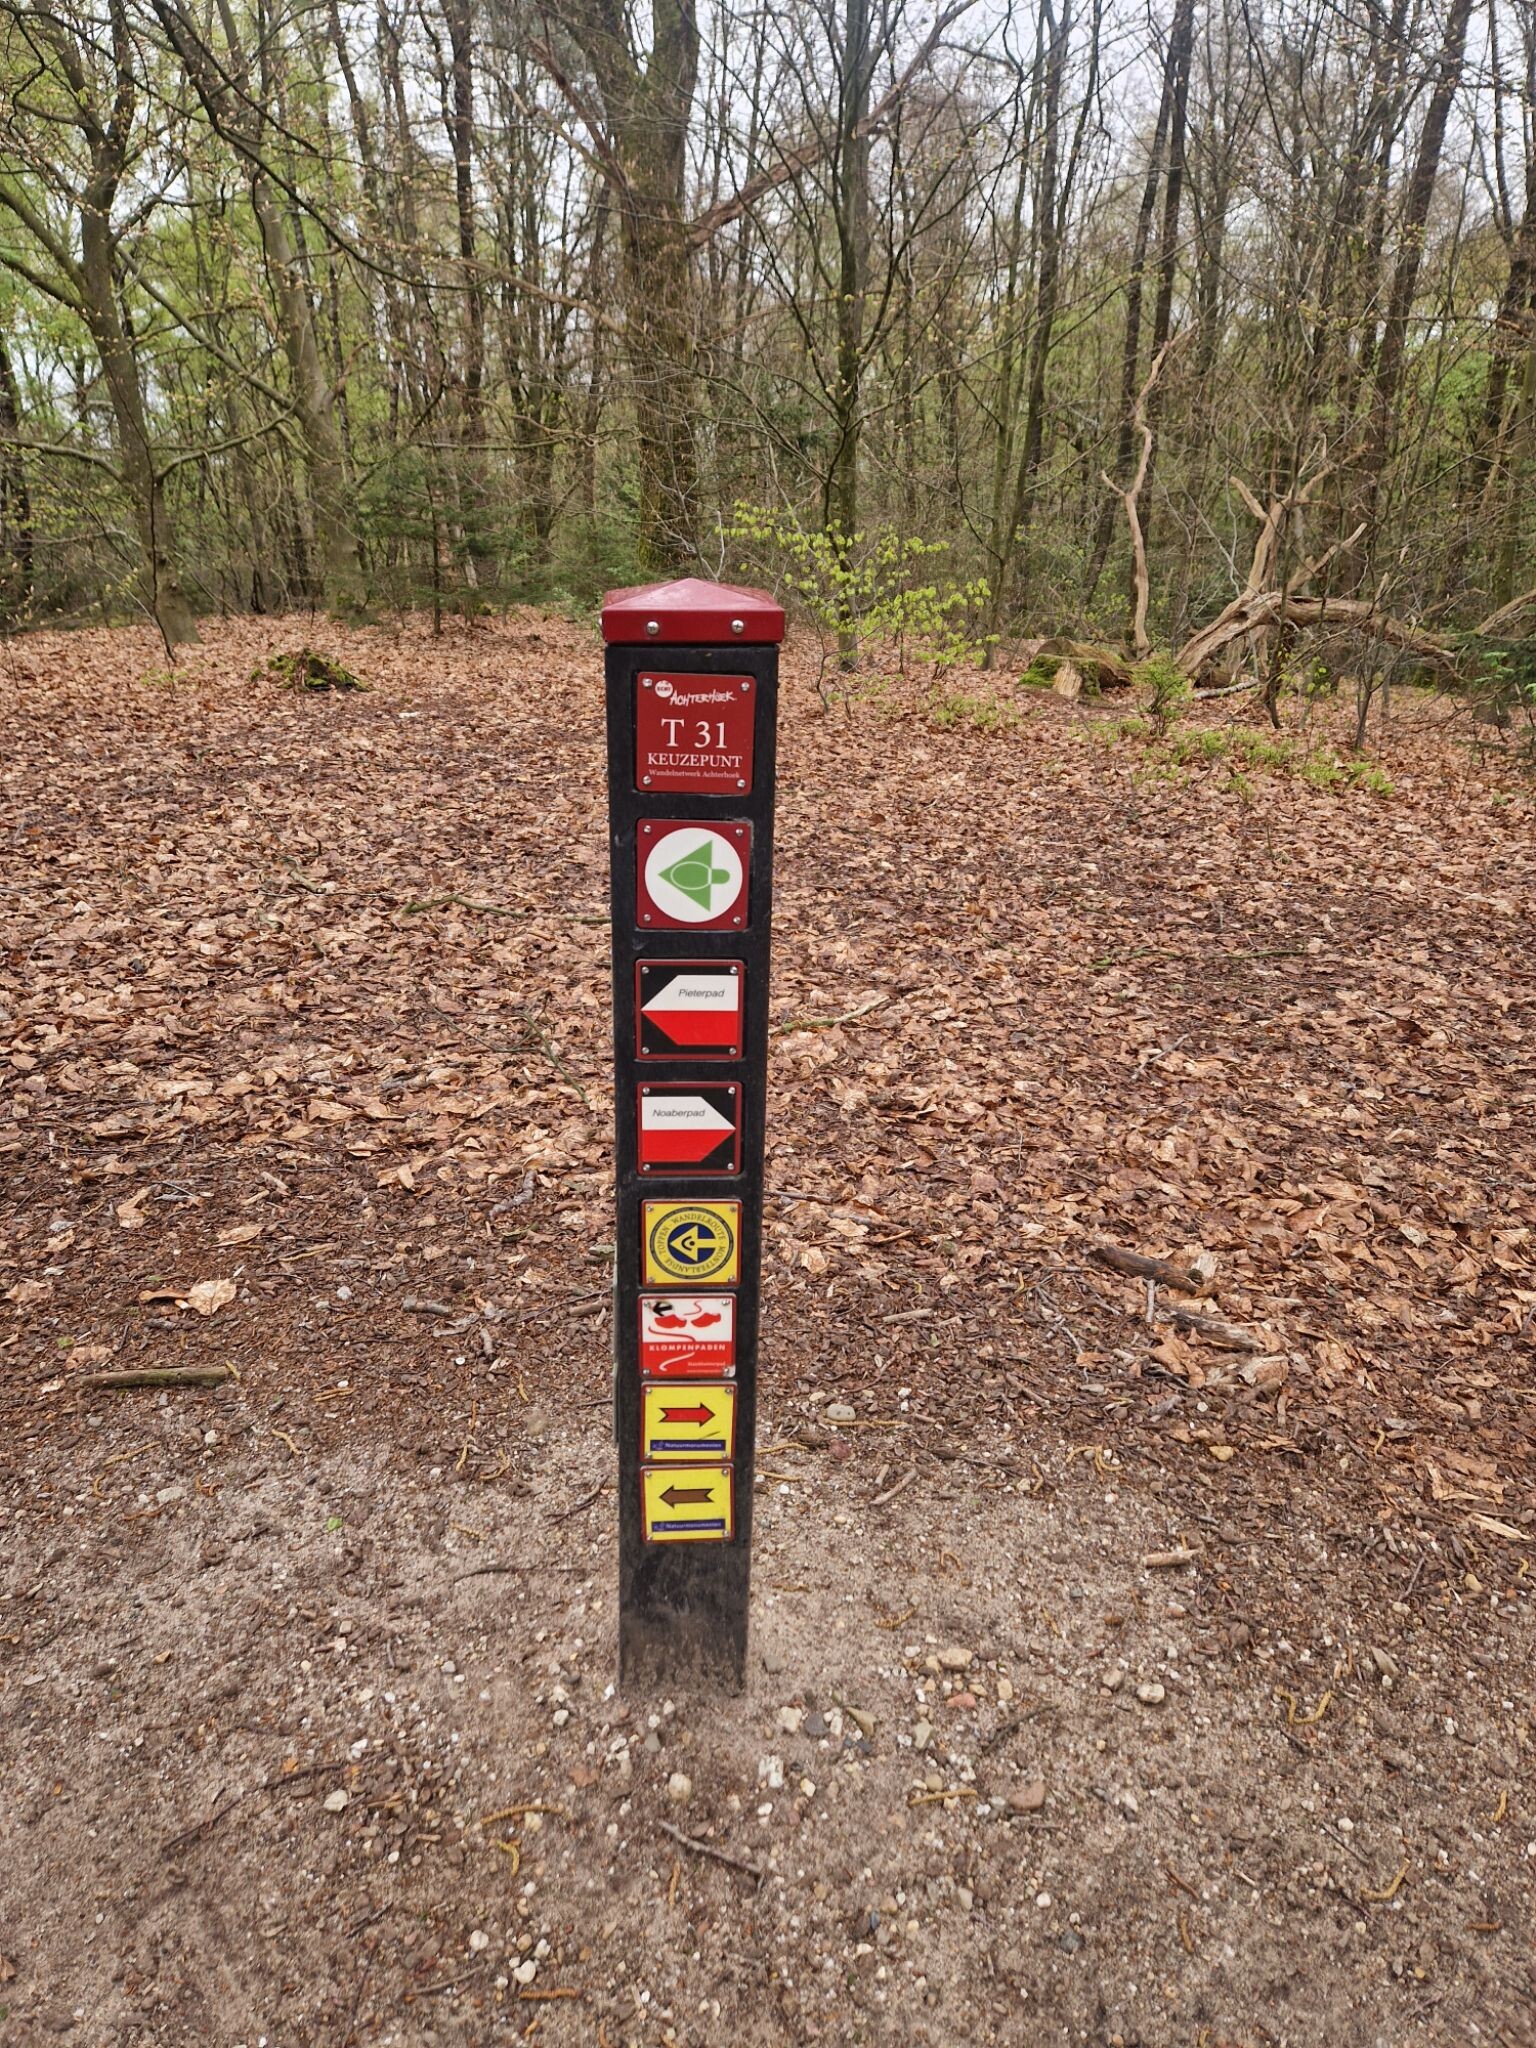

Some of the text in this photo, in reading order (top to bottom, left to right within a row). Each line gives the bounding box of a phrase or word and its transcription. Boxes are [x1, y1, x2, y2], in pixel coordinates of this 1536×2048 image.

[661, 718, 728, 749] T 31
[647, 752, 743, 768] KEUZEPUNT
[648, 768, 740, 779] Wandelnetwerk Achterhoek
[678, 988, 725, 998] Pieterpad
[652, 1108, 706, 1118] Noaberpad
[670, 1213, 726, 1241] WANDELROUTE
[648, 1343, 726, 1352] KLOMPENPADEN
